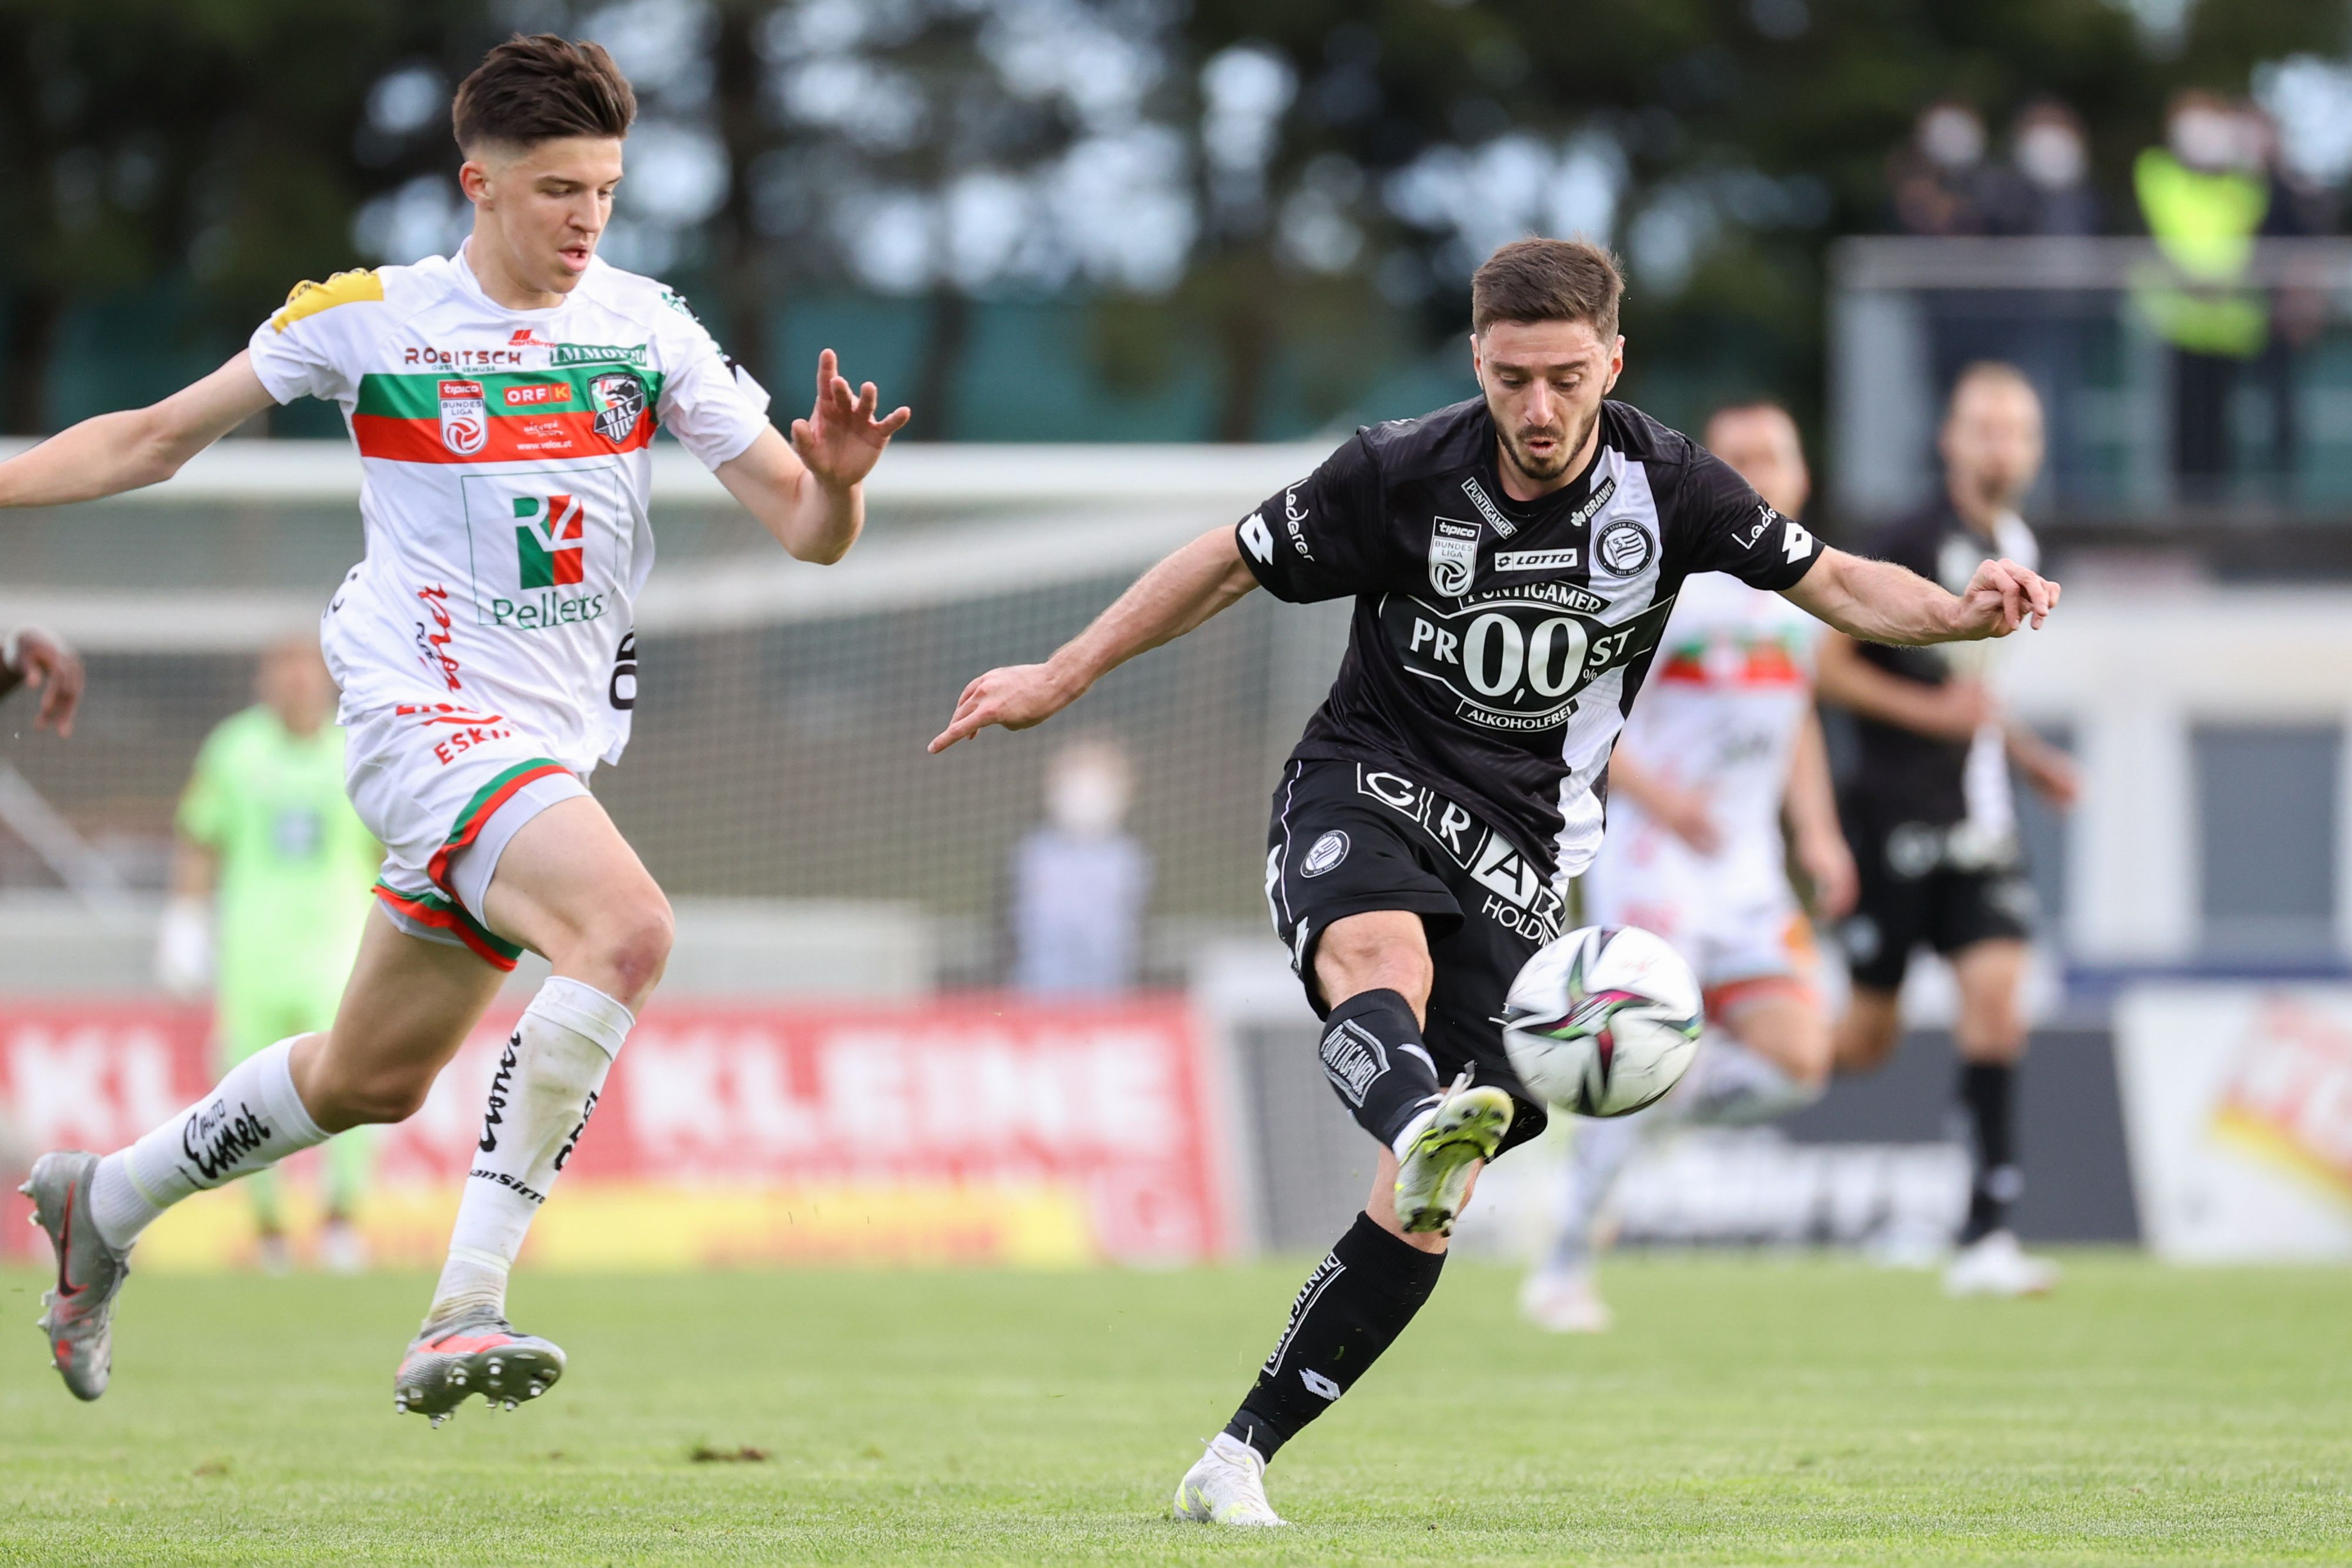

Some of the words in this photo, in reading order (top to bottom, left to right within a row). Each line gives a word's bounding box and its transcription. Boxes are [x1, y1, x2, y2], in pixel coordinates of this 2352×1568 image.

[443, 383, 480, 395] tipico
[507, 387, 546, 403] ORF
[554, 386, 569, 399] K
[602, 401, 636, 424] WAC
[1466, 482, 1514, 537] PUNTIGAMER
[1583, 480, 1615, 518] GRAWE
[1285, 479, 1316, 562] Lederer
[1439, 521, 1476, 538] tipico
[1434, 540, 1474, 552] BUNDES
[1441, 549, 1464, 559] LIGA
[1516, 553, 1574, 565] LOTTO
[492, 590, 603, 629] Pellets
[1467, 706, 1572, 730] ALKOHOLFREI
[627, 1026, 1172, 1157] KLEINE
